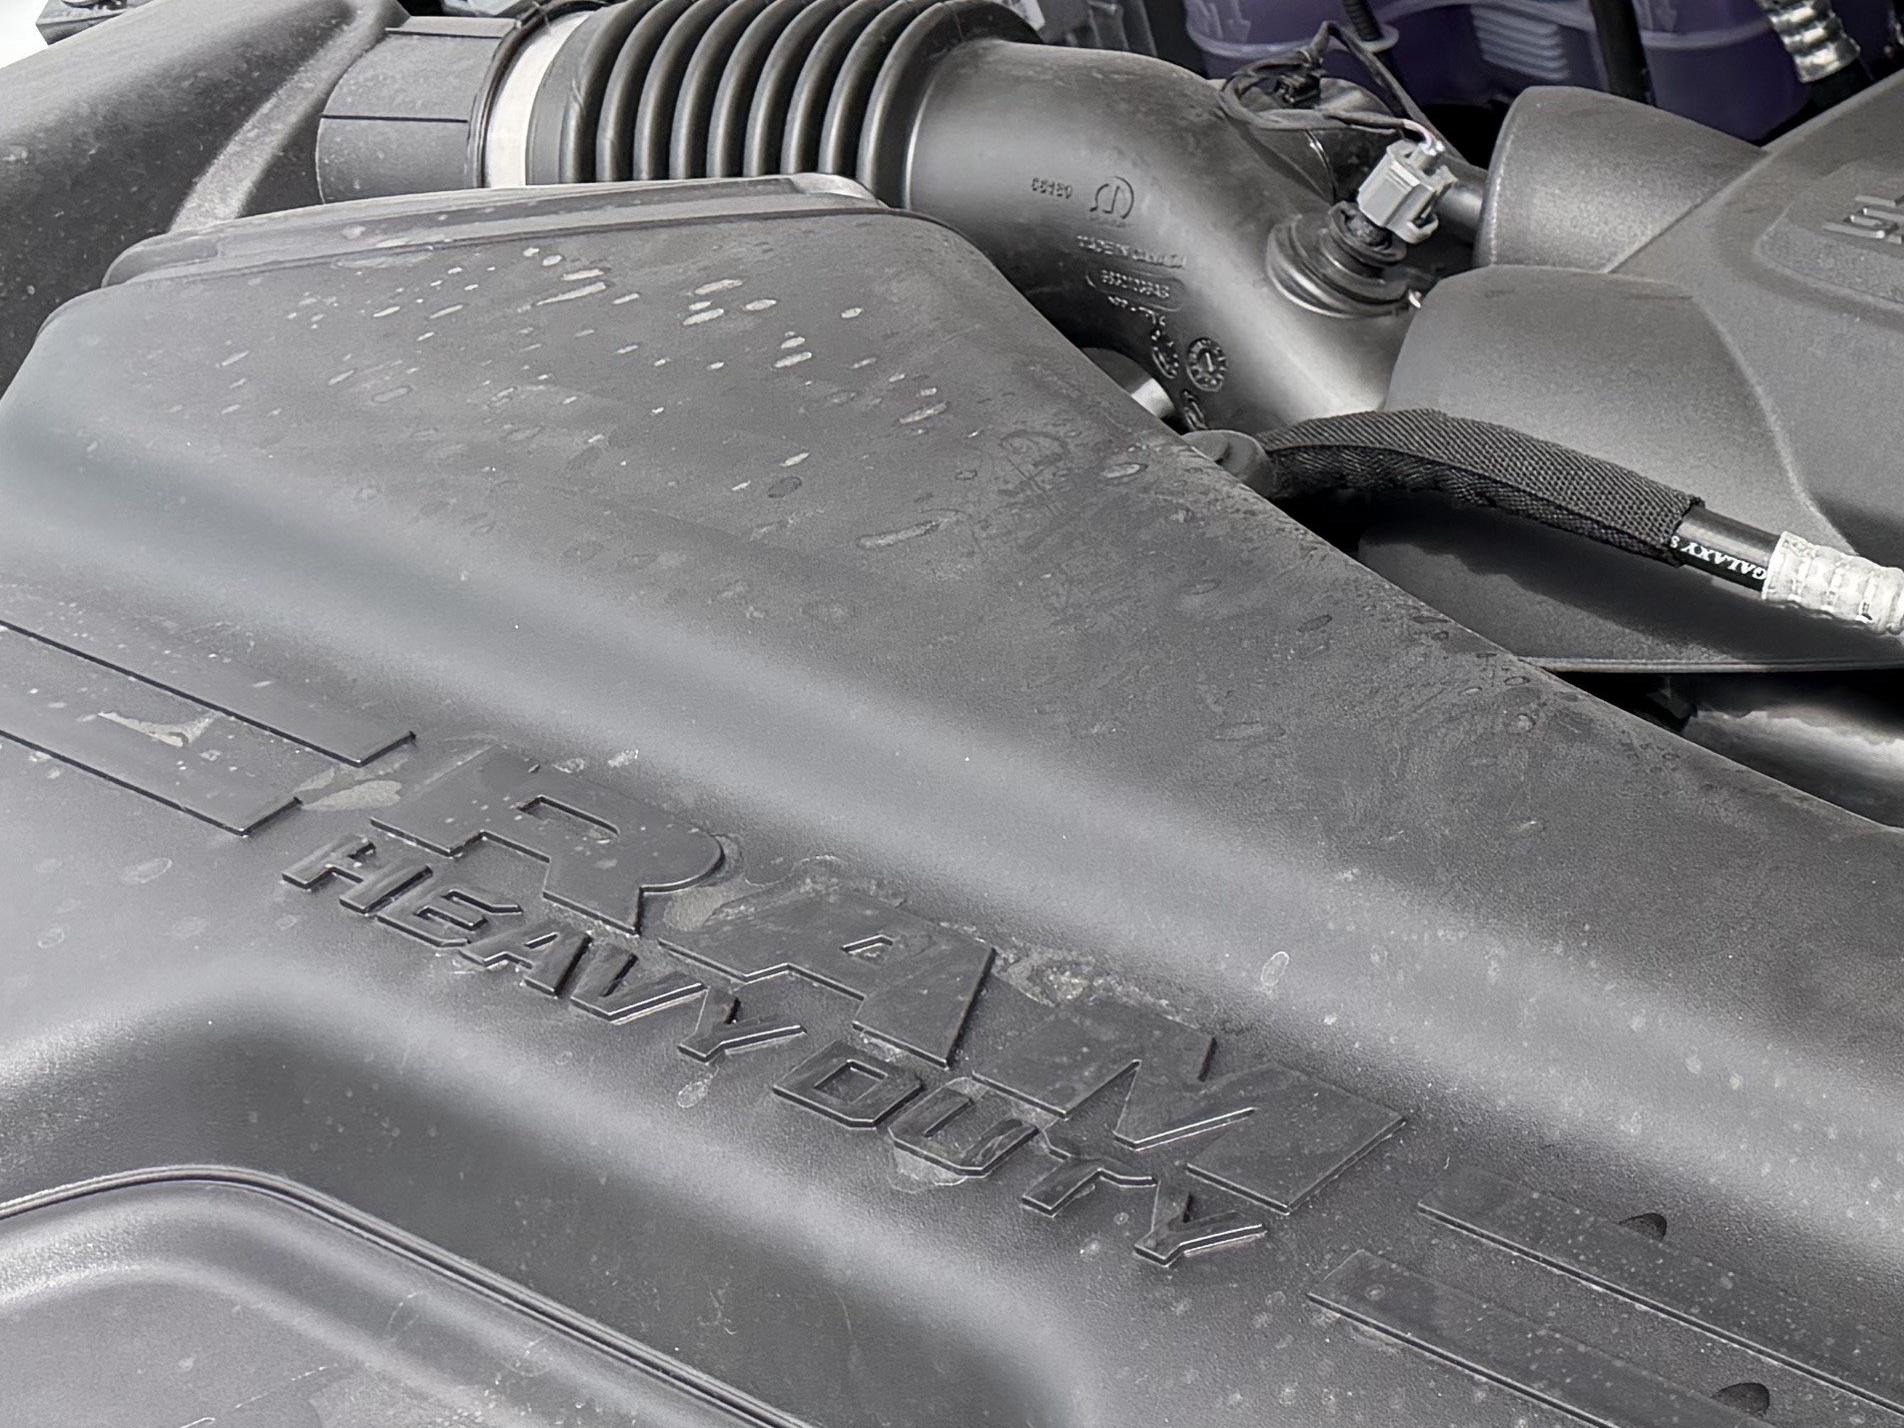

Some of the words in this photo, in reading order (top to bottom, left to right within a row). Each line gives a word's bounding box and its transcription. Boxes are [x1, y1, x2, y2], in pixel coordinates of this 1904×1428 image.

[1680, 540, 1767, 581] GALAXY
[280, 830, 806, 1065] HEAVY
[771, 1038, 1270, 1269] DUTY
[366, 743, 1408, 1216] RAM
